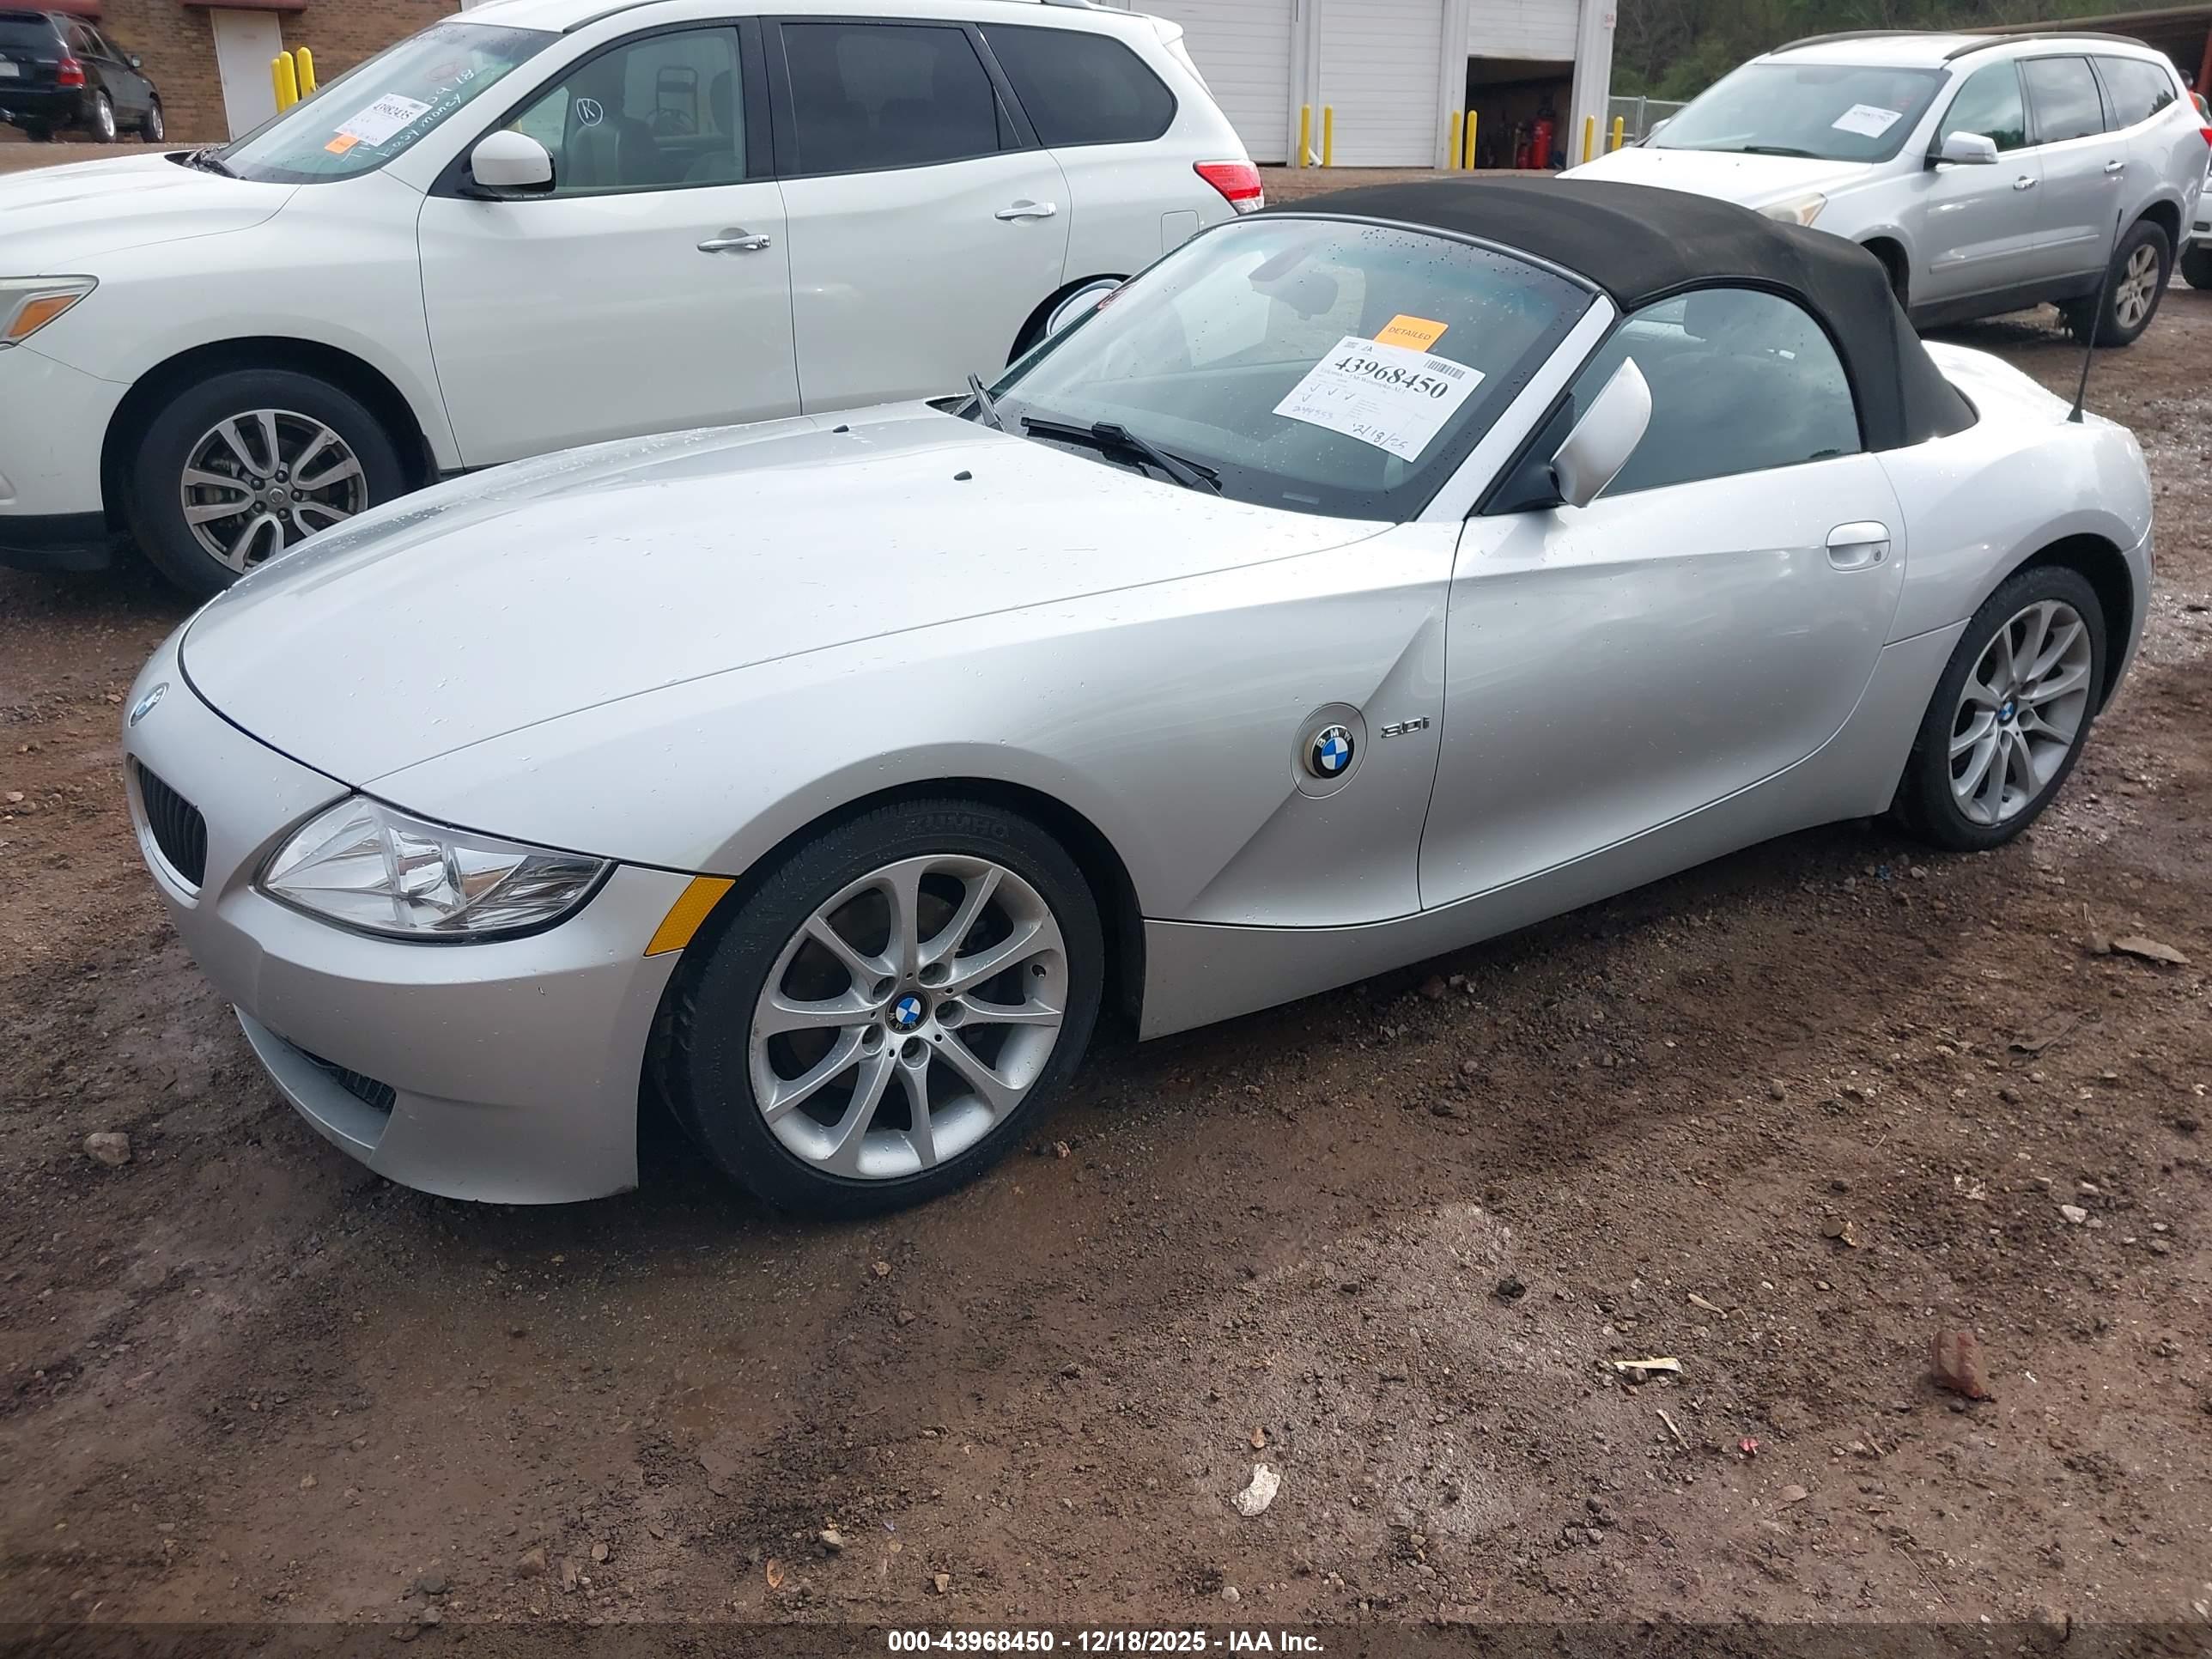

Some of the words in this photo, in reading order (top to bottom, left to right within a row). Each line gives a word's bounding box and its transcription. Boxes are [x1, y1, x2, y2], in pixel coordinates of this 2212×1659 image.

[1388, 326, 1431, 341] DETAILED
[1334, 356, 1449, 399] 43968450
[1316, 727, 1352, 749] BMW
